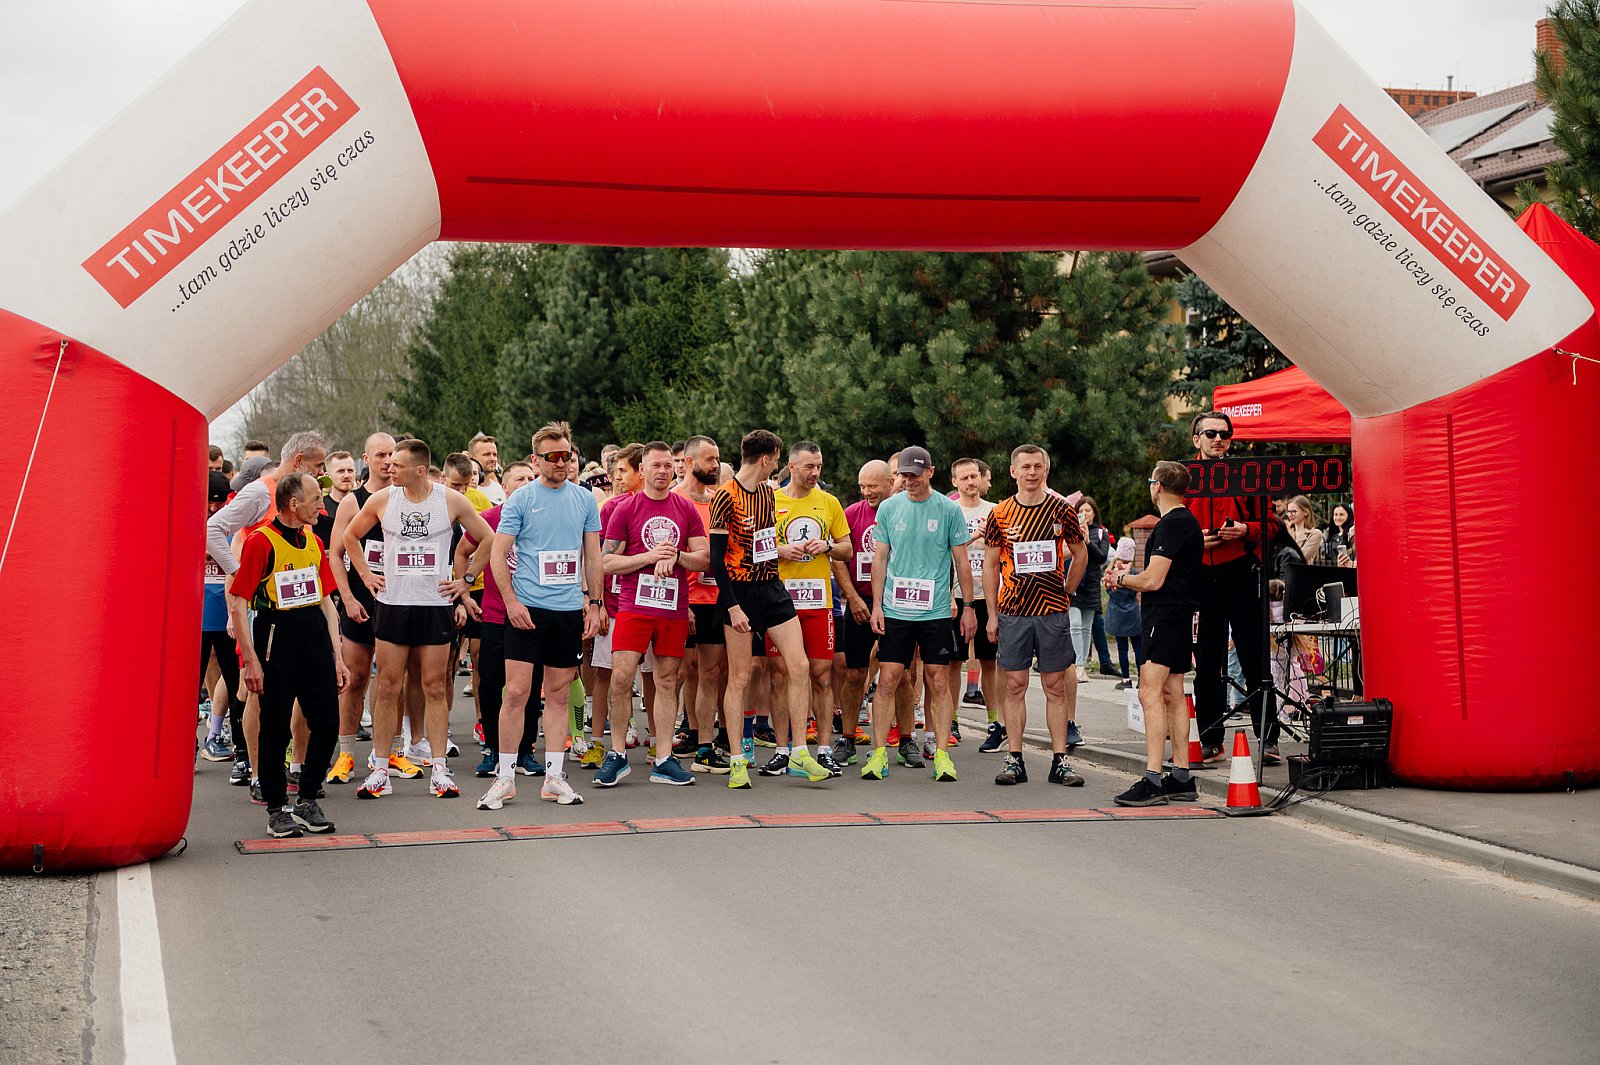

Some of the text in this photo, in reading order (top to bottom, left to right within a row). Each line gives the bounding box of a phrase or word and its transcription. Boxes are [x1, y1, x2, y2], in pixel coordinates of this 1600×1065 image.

[106, 87, 338, 279] TIMEKEEPER
[1337, 122, 1517, 303] TIMEKEEPER
[171, 130, 375, 312] ...tam gdzie liczy się czas
[1313, 179, 1490, 337] ...tam gdzie liczy się czas
[1221, 403, 1263, 418] TIMEKEEPER
[402, 525, 428, 535] JAKOB
[760, 538, 775, 550] 113
[407, 554, 425, 566] 115
[1025, 552, 1044, 563] 126
[555, 562, 568, 574] 96
[970, 560, 982, 569] 62
[293, 582, 308, 596] 54
[649, 586, 666, 599] 118
[796, 589, 814, 600] 124
[904, 588, 920, 600] 121
